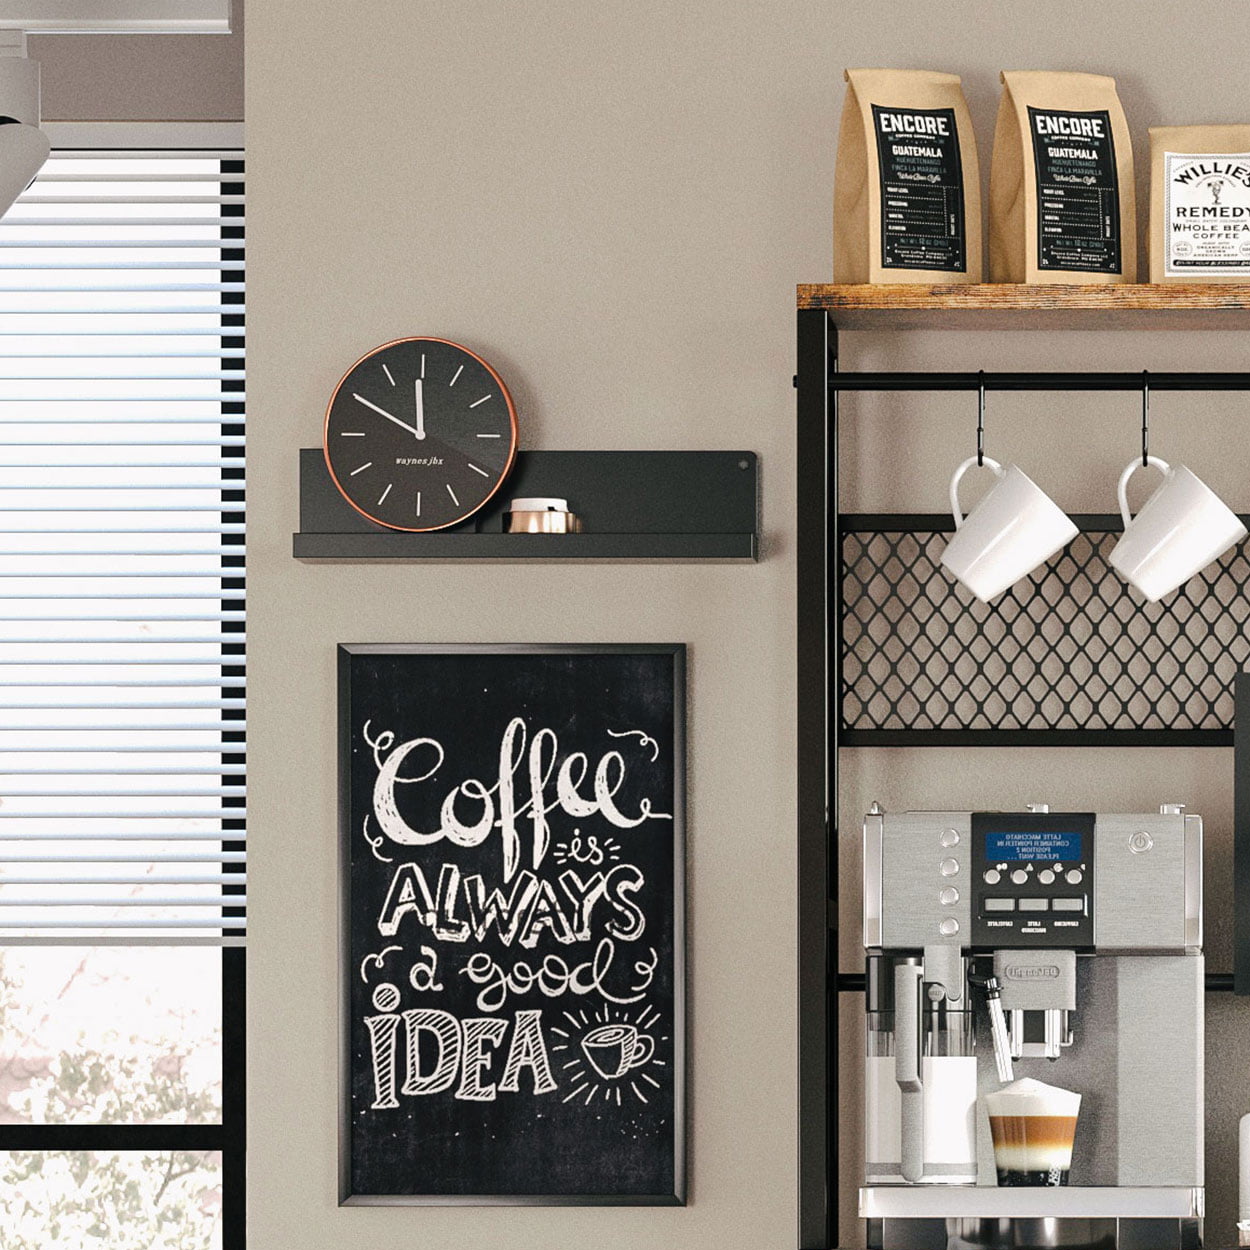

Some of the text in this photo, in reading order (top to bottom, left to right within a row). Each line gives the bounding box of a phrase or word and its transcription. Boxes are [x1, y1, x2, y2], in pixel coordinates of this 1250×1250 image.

[880, 113, 949, 136] ENCORE
[1035, 115, 1104, 138] ENCORE
[892, 145, 943, 158] GUATEMALA
[1048, 147, 1098, 160] GUATEMALA
[1172, 222, 1218, 232] WHOLE
[373, 716, 673, 884] Coffee
[569, 828, 603, 865] is
[378, 862, 646, 949] ALWAYS
[409, 938, 647, 1013] a good
